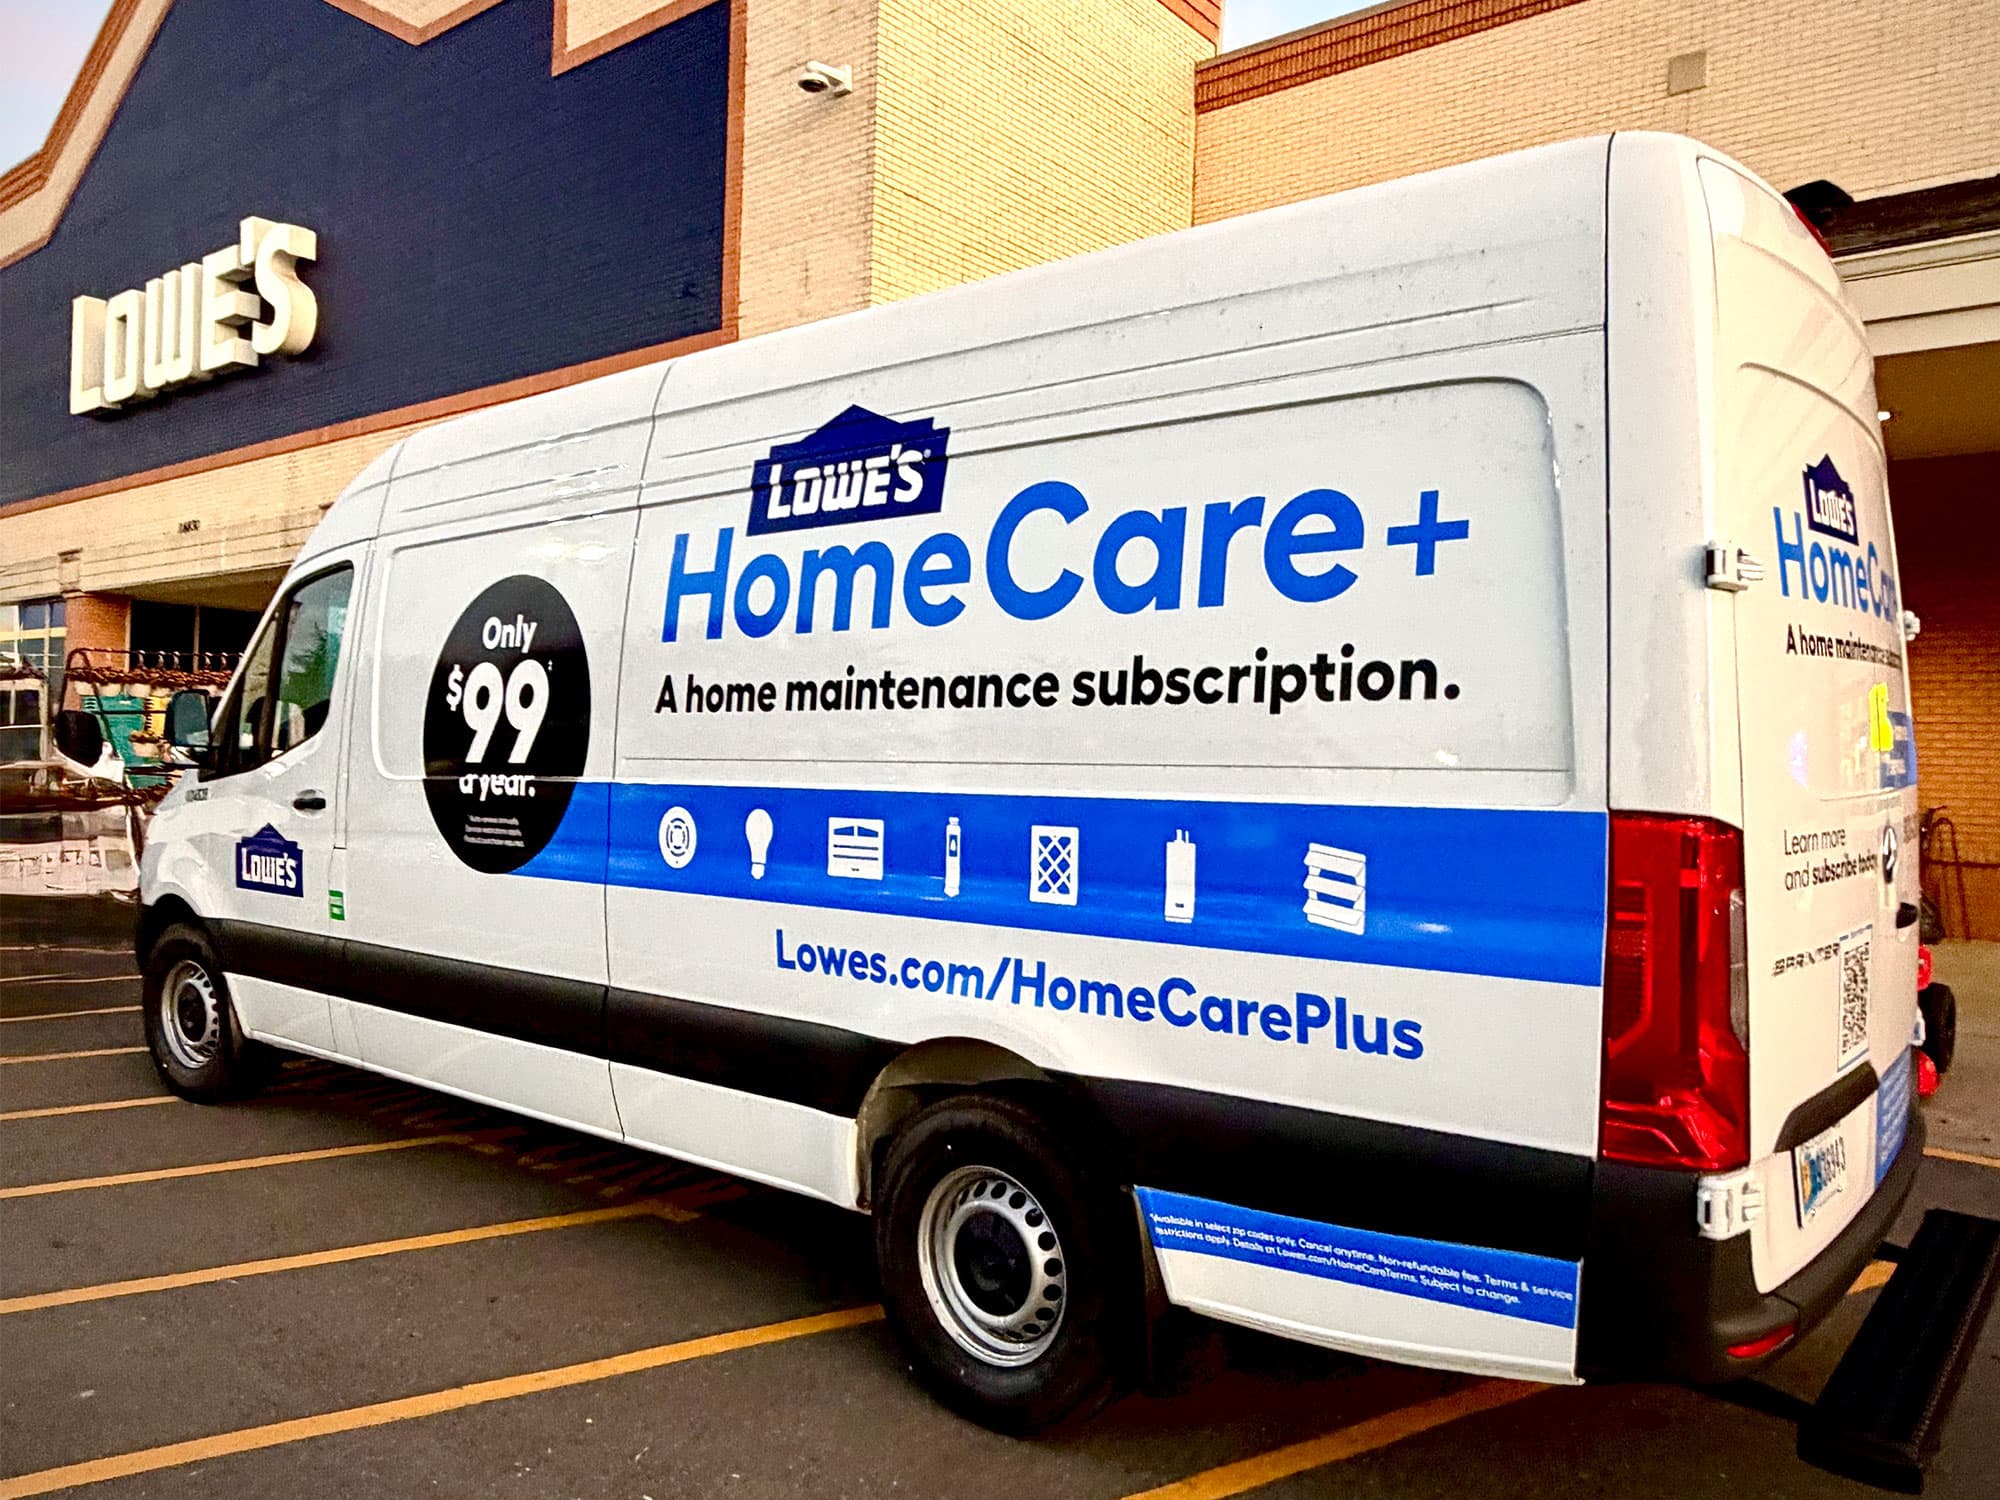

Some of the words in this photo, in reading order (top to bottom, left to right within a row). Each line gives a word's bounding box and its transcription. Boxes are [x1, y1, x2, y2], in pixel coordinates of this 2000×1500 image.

[70, 216, 318, 415] LOWE'S
[767, 444, 931, 520] LOWE'S
[1809, 478, 1855, 537] LOWE'S
[662, 480, 1470, 643] HomeCare+
[482, 614, 537, 653] Only
[1786, 624, 1798, 655] A
[1798, 623, 1834, 658] home
[655, 676, 681, 714] A
[685, 674, 775, 714] home
[785, 664, 1060, 711] maintenance
[1071, 642, 1461, 714] subscription.
[479, 773, 536, 801] year.
[241, 846, 297, 889] LOWE'S
[1784, 829, 1819, 856] Learn
[1821, 828, 1846, 848] more
[1784, 861, 1810, 891] and
[1812, 852, 1857, 886] subscribe
[776, 929, 1423, 1060] Lowes.com/HomeCarePlus
[1155, 1226, 1204, 1242] restrictions
[1232, 1236, 1264, 1254] Details
[1419, 1274, 1460, 1294] Subject
[1462, 1284, 1475, 1296] to
[1475, 1288, 1521, 1305] change.
[1194, 1218, 1204, 1229] in
[1204, 1221, 1231, 1234] select
[1232, 1226, 1246, 1237] zip
[1246, 1230, 1275, 1243] codes
[1275, 1235, 1297, 1248] only.
[1298, 1237, 1333, 1254] Cancel
[1333, 1246, 1378, 1263] anytime.
[1378, 1253, 1460, 1280] Non-refundable
[1484, 1273, 1519, 1291] Terms
[1520, 1281, 1530, 1293] &
[1531, 1285, 1574, 1302] service
